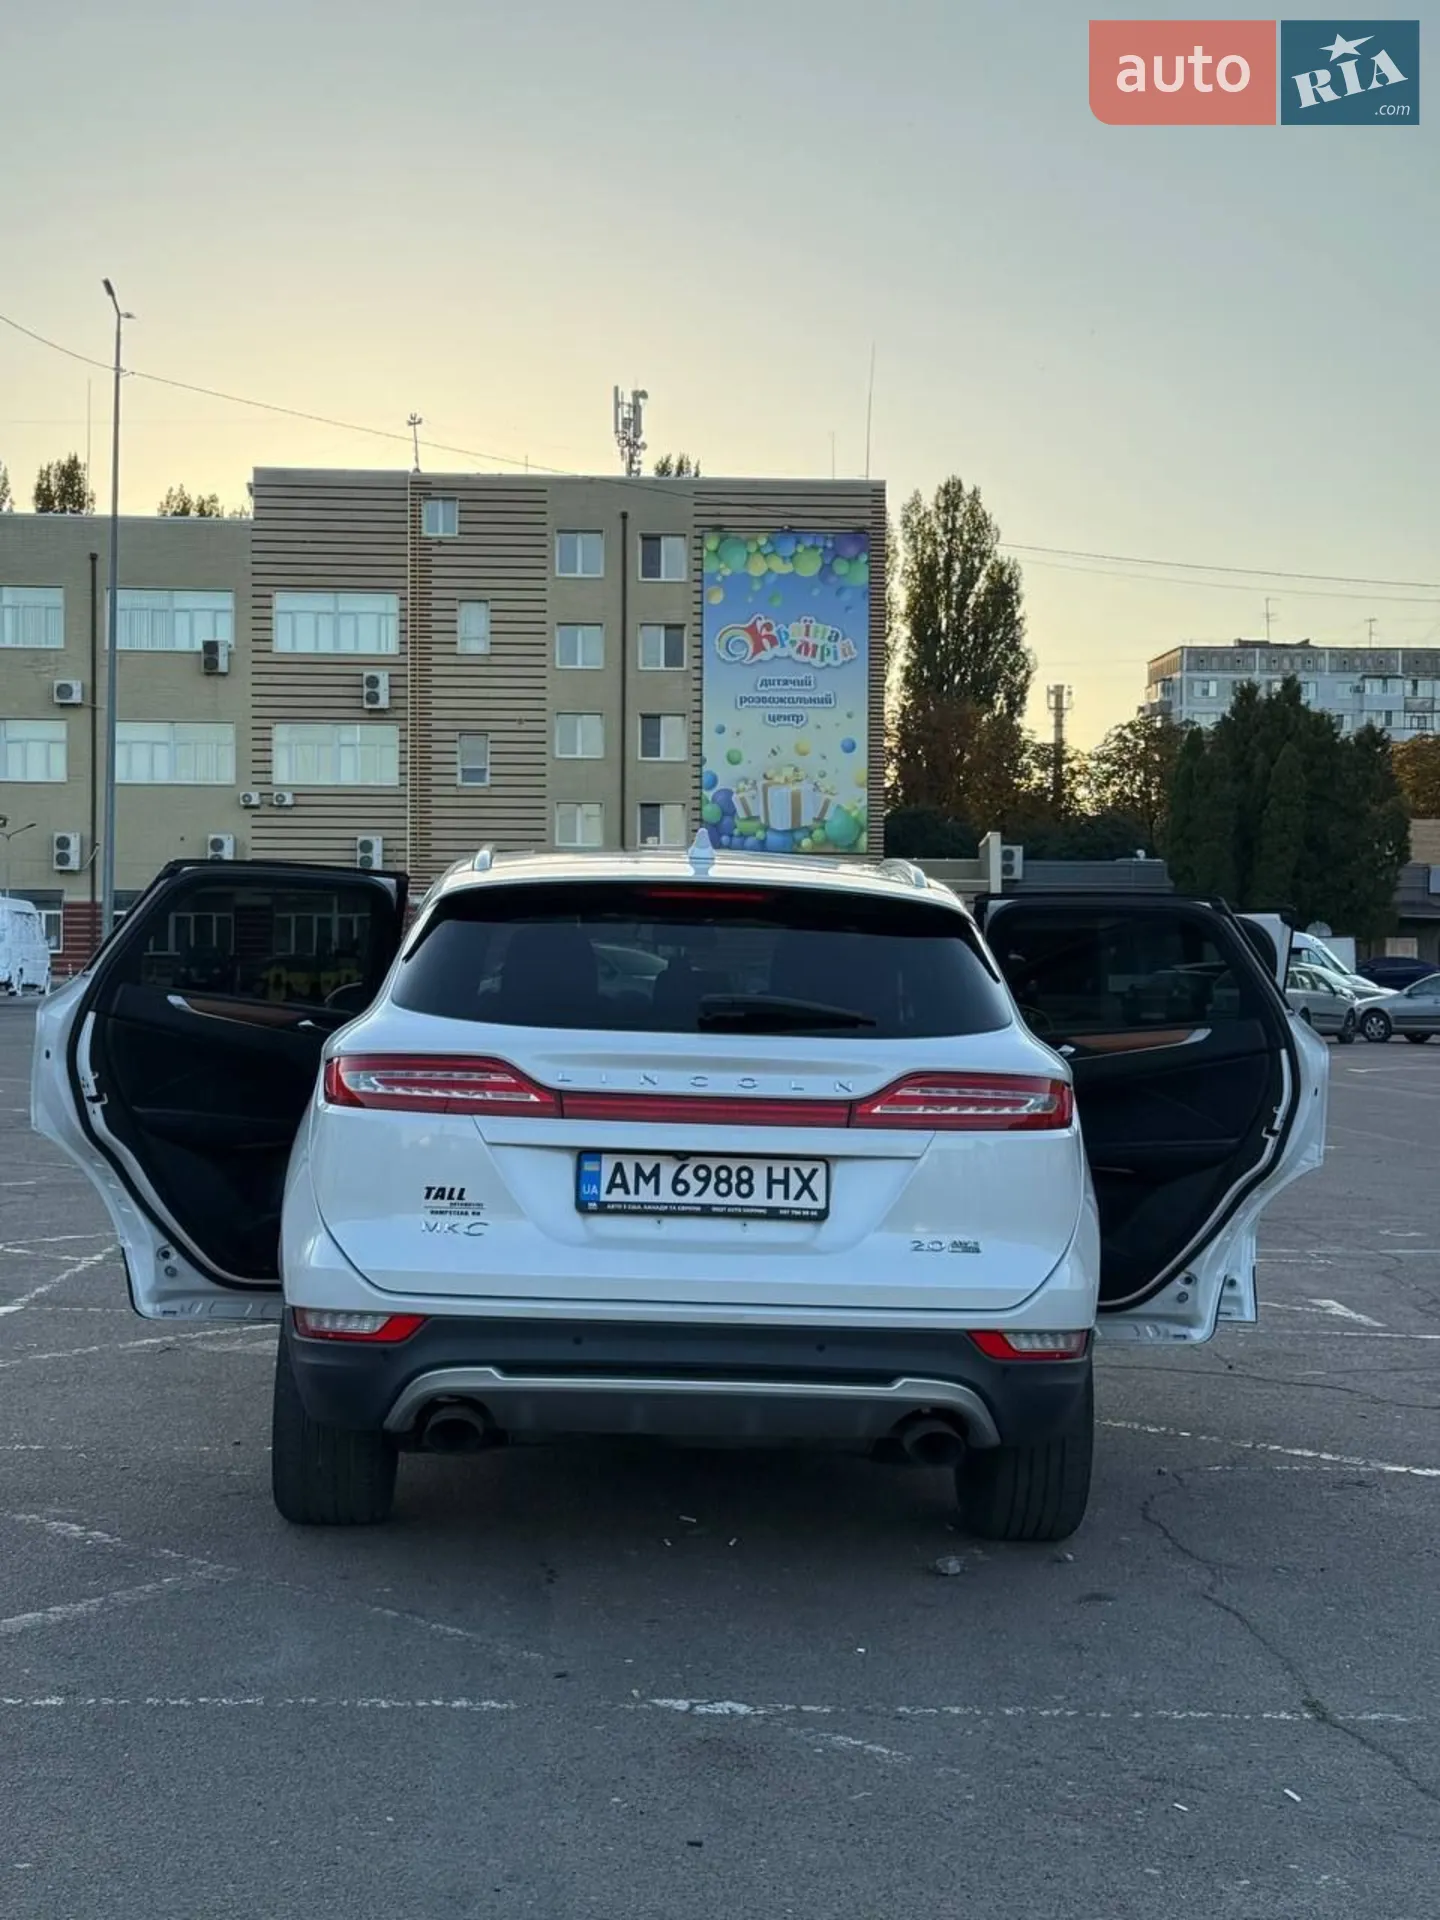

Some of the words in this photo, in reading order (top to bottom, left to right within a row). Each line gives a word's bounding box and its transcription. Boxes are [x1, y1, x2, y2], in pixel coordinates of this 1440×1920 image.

[759, 675, 813, 688] дитячий
[739, 694, 832, 707] розважальний
[767, 713, 805, 725] центр
[557, 1072, 853, 1092] LINCOLN
[671, 1163, 755, 1199] 6988
[424, 1186, 466, 1201] TALL
[583, 1184, 599, 1195] UA
[421, 1221, 490, 1237] MKC
[911, 1240, 946, 1253] 2.0
